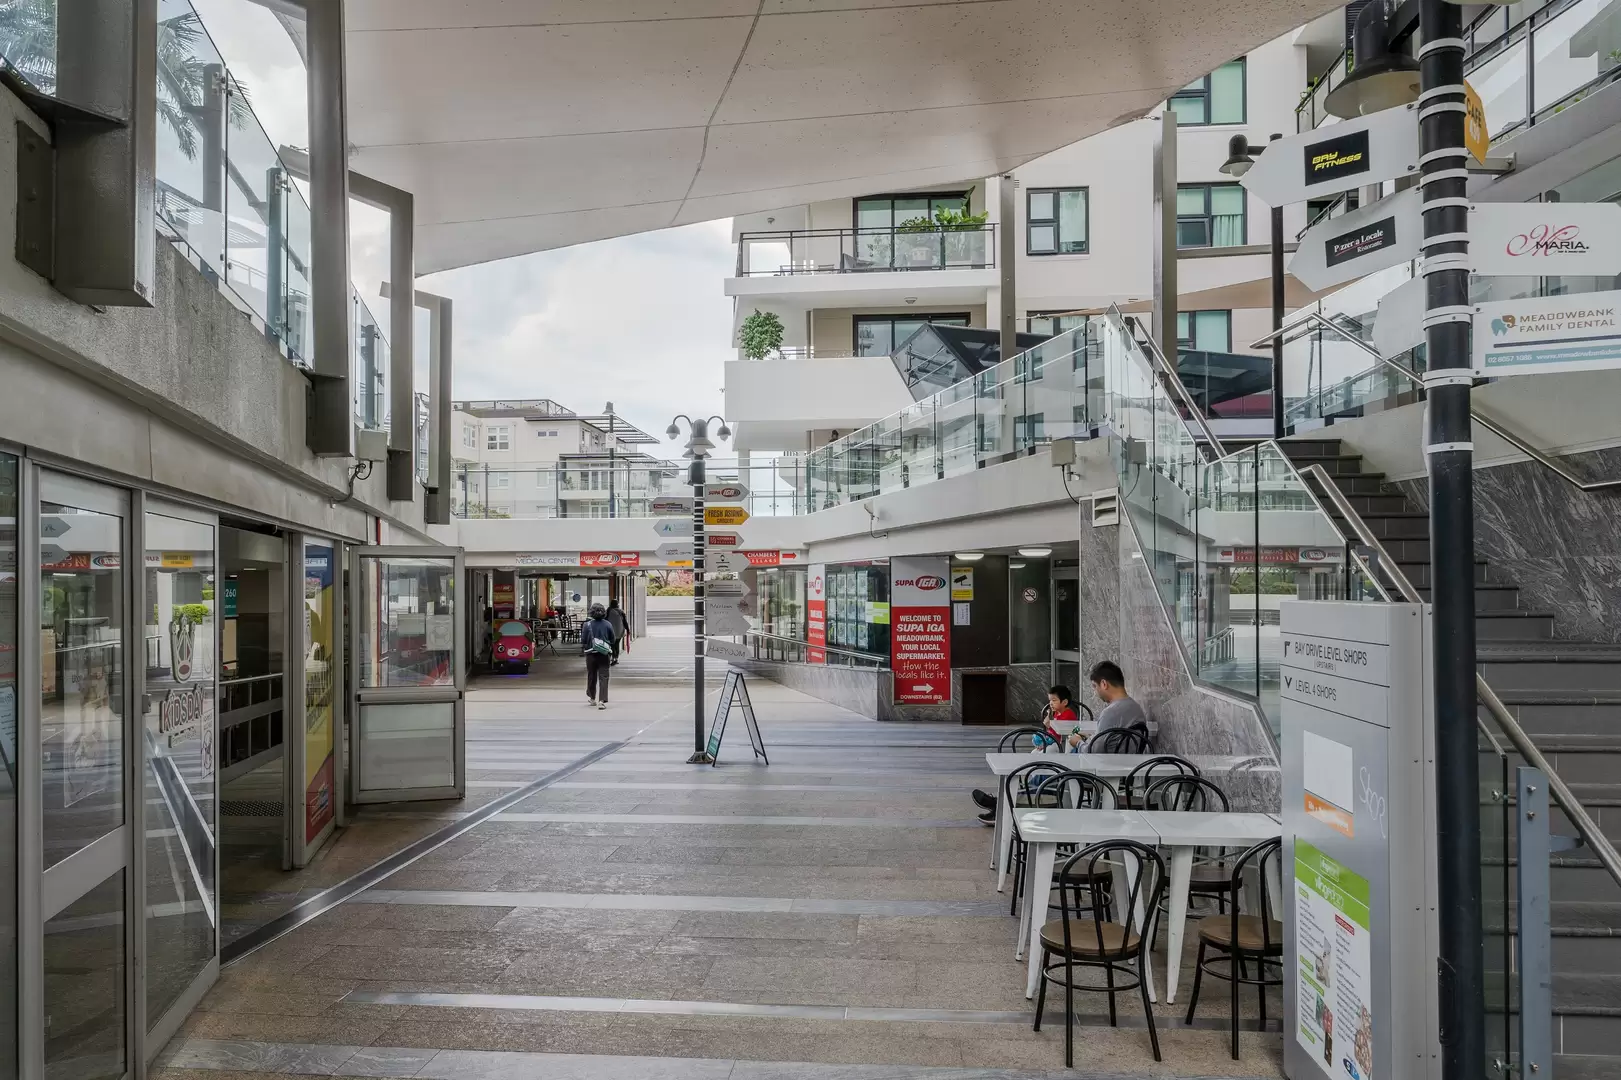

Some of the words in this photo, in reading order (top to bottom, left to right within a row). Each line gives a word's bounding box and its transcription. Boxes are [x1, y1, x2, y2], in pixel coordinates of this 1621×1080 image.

[1466, 97, 1482, 129] CAFE
[1312, 151, 1339, 165] BAY
[1314, 152, 1362, 171] FITNESS
[1361, 229, 1384, 243] Locale
[1520, 308, 1615, 323] MEADOWBANK
[1520, 322, 1564, 333] FAMILY
[1567, 318, 1616, 329] DENTAL
[722, 489, 736, 498] IGA
[515, 556, 546, 564] MEDICAL
[547, 556, 577, 564] CENTRE
[598, 554, 613, 562] IGA
[894, 579, 915, 587] SUPA
[917, 578, 937, 588] IGA
[932, 614, 942, 622] TO
[896, 623, 924, 632] SUPA
[926, 623, 945, 632] IGA
[896, 634, 946, 643] MEADOWBANK,
[901, 643, 919, 651] YOUR
[919, 643, 941, 651] LOCAL
[896, 652, 946, 660] SUPERMARKET.
[1295, 641, 1305, 655] BAY
[1306, 643, 1323, 658] DRIVE
[1323, 646, 1343, 662] LEVEL
[1343, 648, 1368, 666] SHOPS
[902, 660, 922, 671] How
[923, 661, 940, 670] the
[895, 670, 918, 679] locals
[920, 670, 935, 679] like
[936, 670, 947, 679] it.
[1295, 680, 1312, 695] LEVEL
[1312, 684, 1317, 696] 4
[1316, 684, 1337, 701] SHOPS
